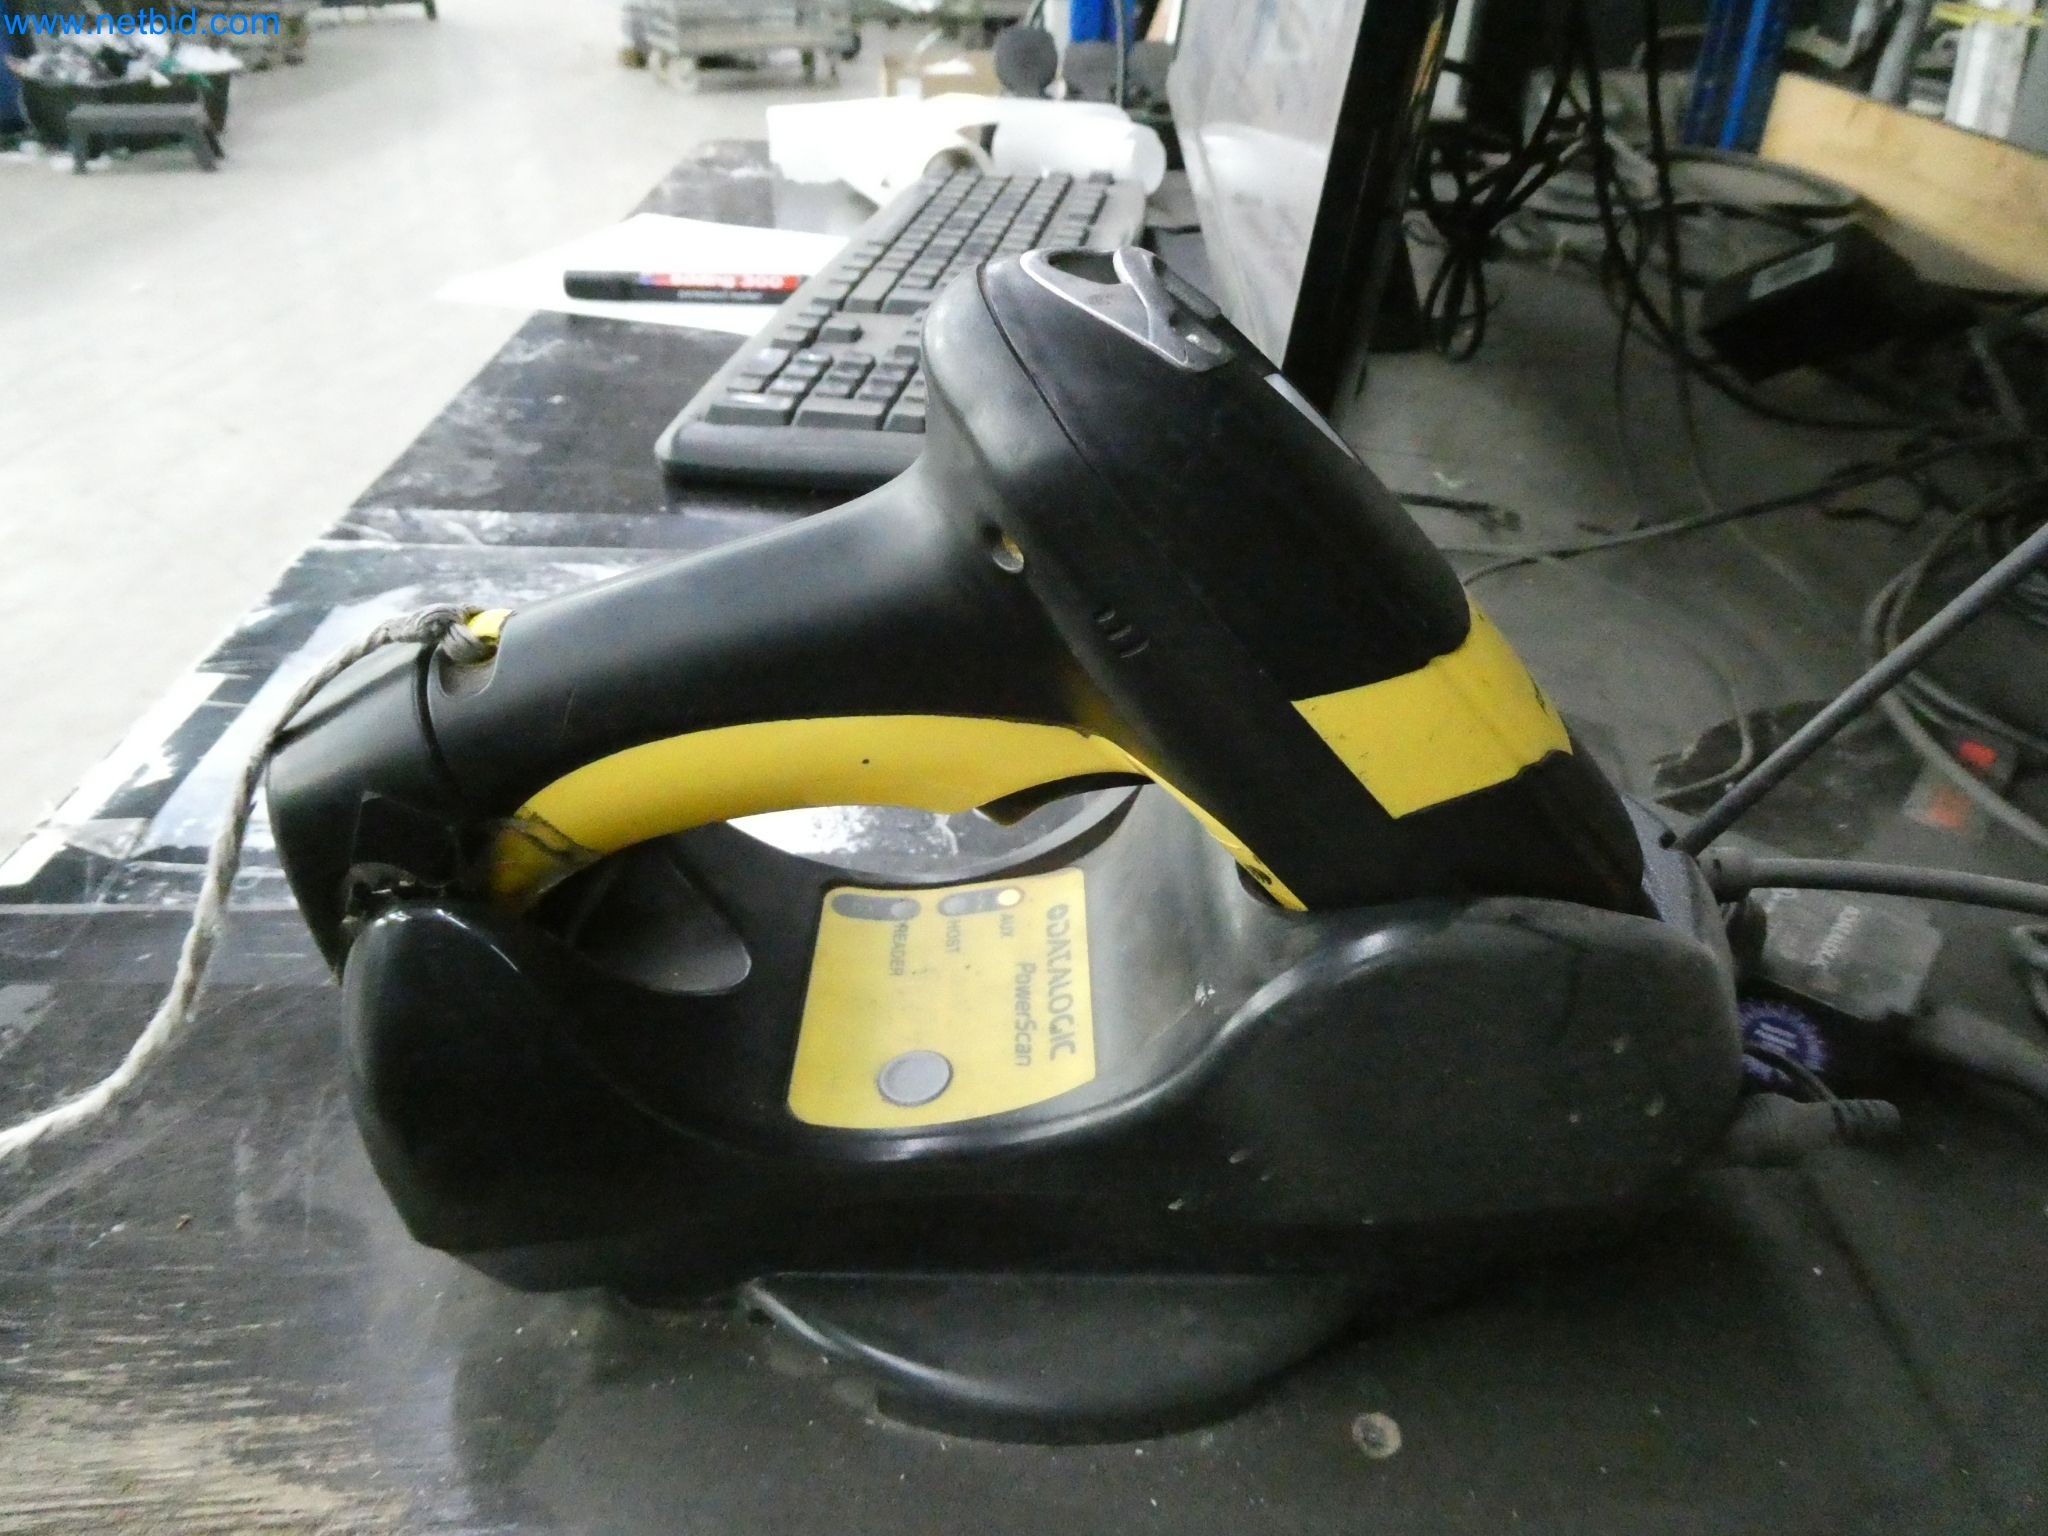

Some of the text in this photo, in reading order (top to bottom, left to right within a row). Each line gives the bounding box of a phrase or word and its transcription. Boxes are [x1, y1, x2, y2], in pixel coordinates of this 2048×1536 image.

[889, 923, 909, 977] READER
[946, 919, 962, 953] HOST
[1000, 913, 1014, 938] AUX
[1014, 962, 1037, 1067] PowerScan
[1046, 919, 1076, 1061] DATALOGIC
